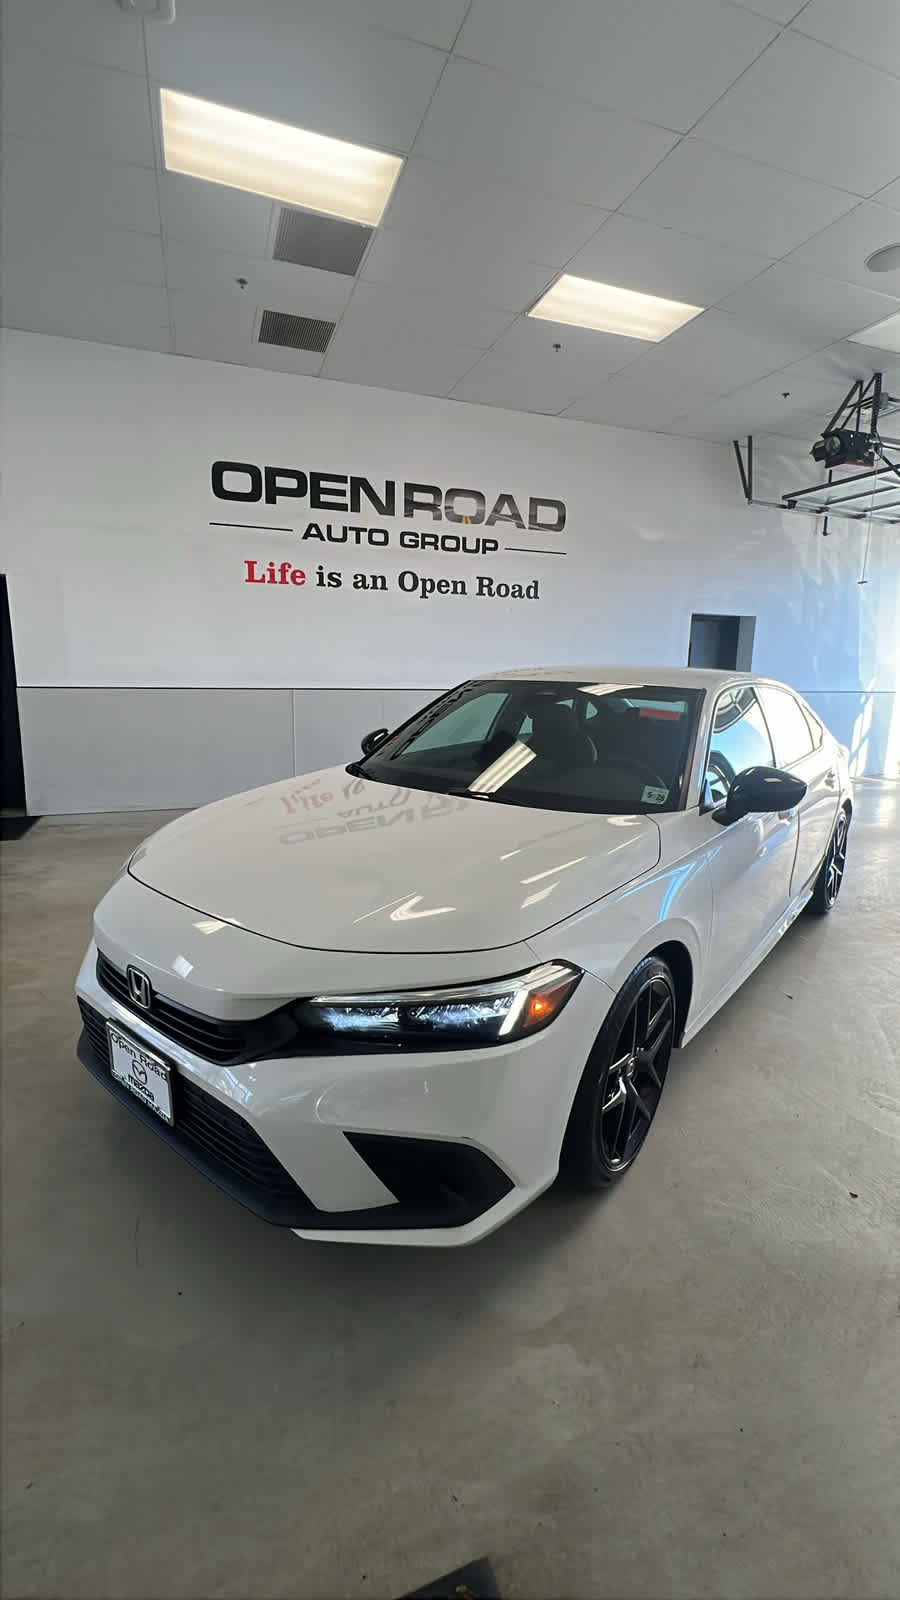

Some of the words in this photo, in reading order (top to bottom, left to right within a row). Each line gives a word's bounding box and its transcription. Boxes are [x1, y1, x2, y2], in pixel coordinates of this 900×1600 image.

[301, 522, 390, 547] AUTO
[399, 530, 500, 555] GROUP
[244, 560, 306, 586] Life
[315, 565, 342, 589] is
[352, 572, 389, 591] an
[397, 570, 468, 599] Open
[475, 575, 540, 600] Road
[110, 1032, 137, 1059] Open
[139, 1054, 168, 1081] Road
